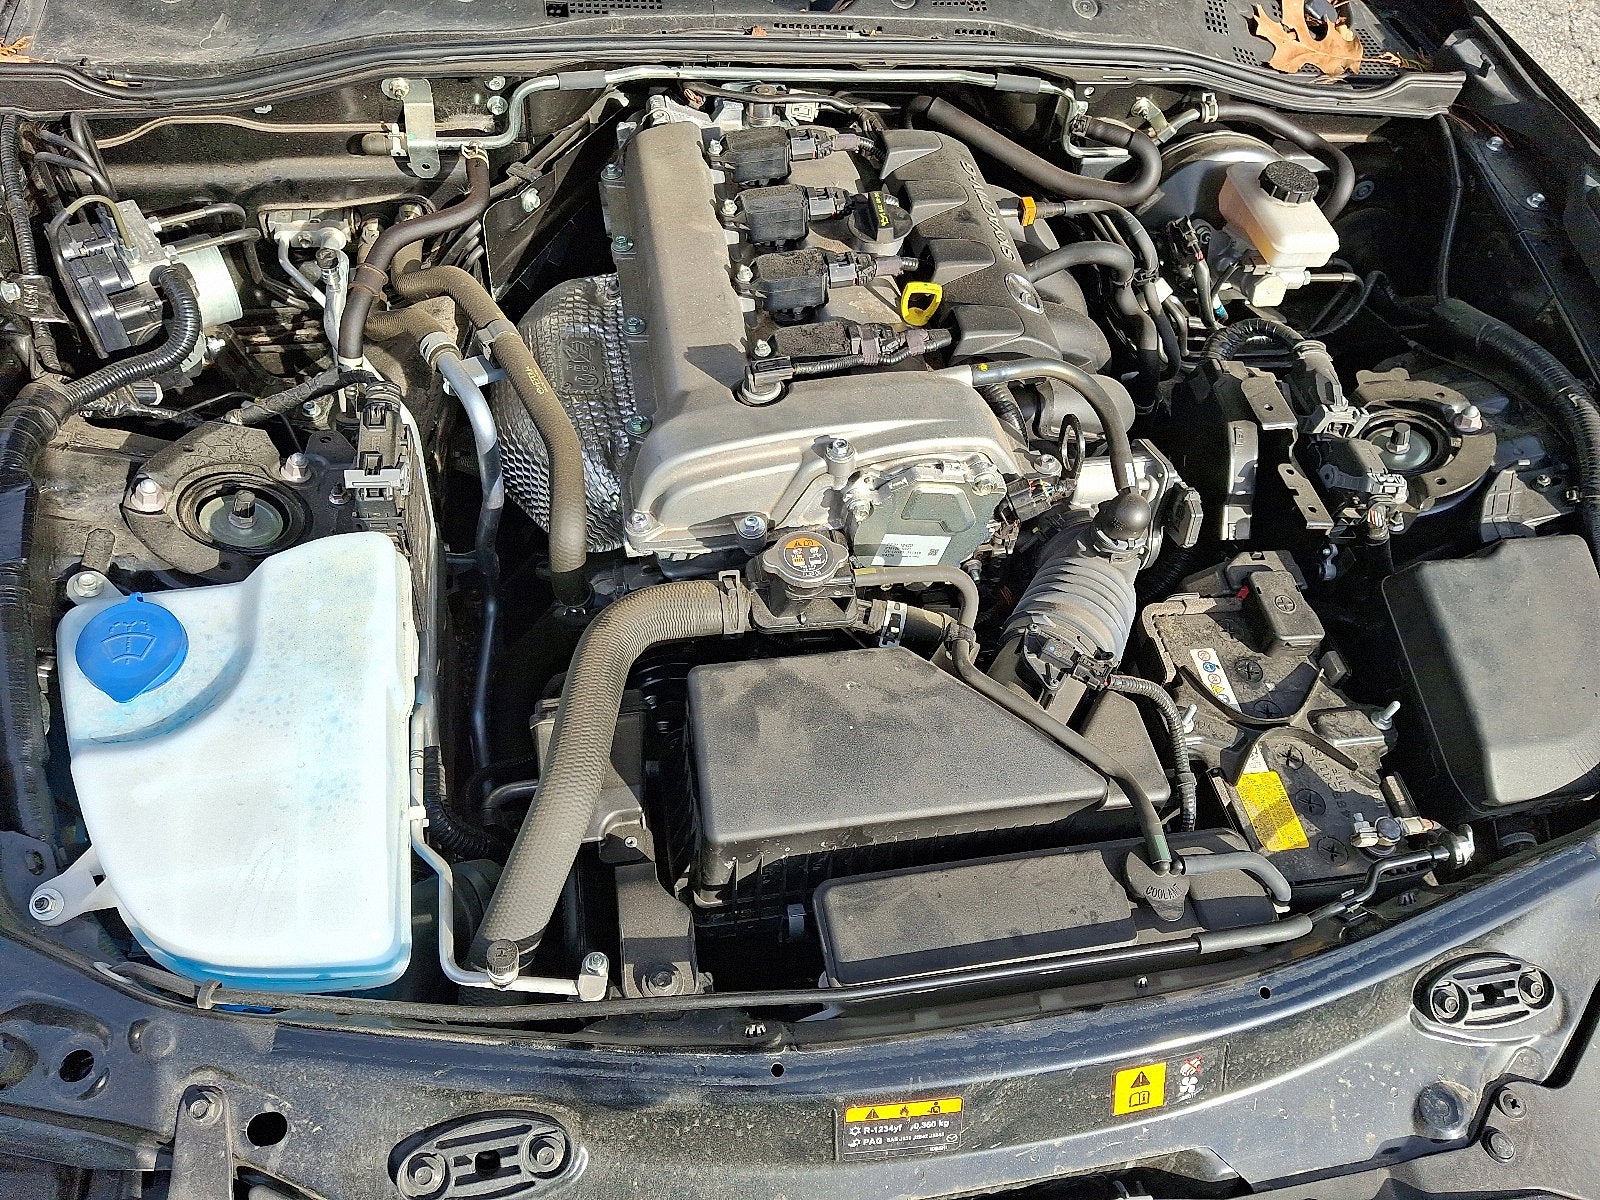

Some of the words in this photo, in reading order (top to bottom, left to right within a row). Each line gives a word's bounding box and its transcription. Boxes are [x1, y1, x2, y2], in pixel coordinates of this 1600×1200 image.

[1145, 883, 1183, 900] COOLANT
[863, 1124, 903, 1135] R-1234yf
[938, 1119, 950, 1129] kg
